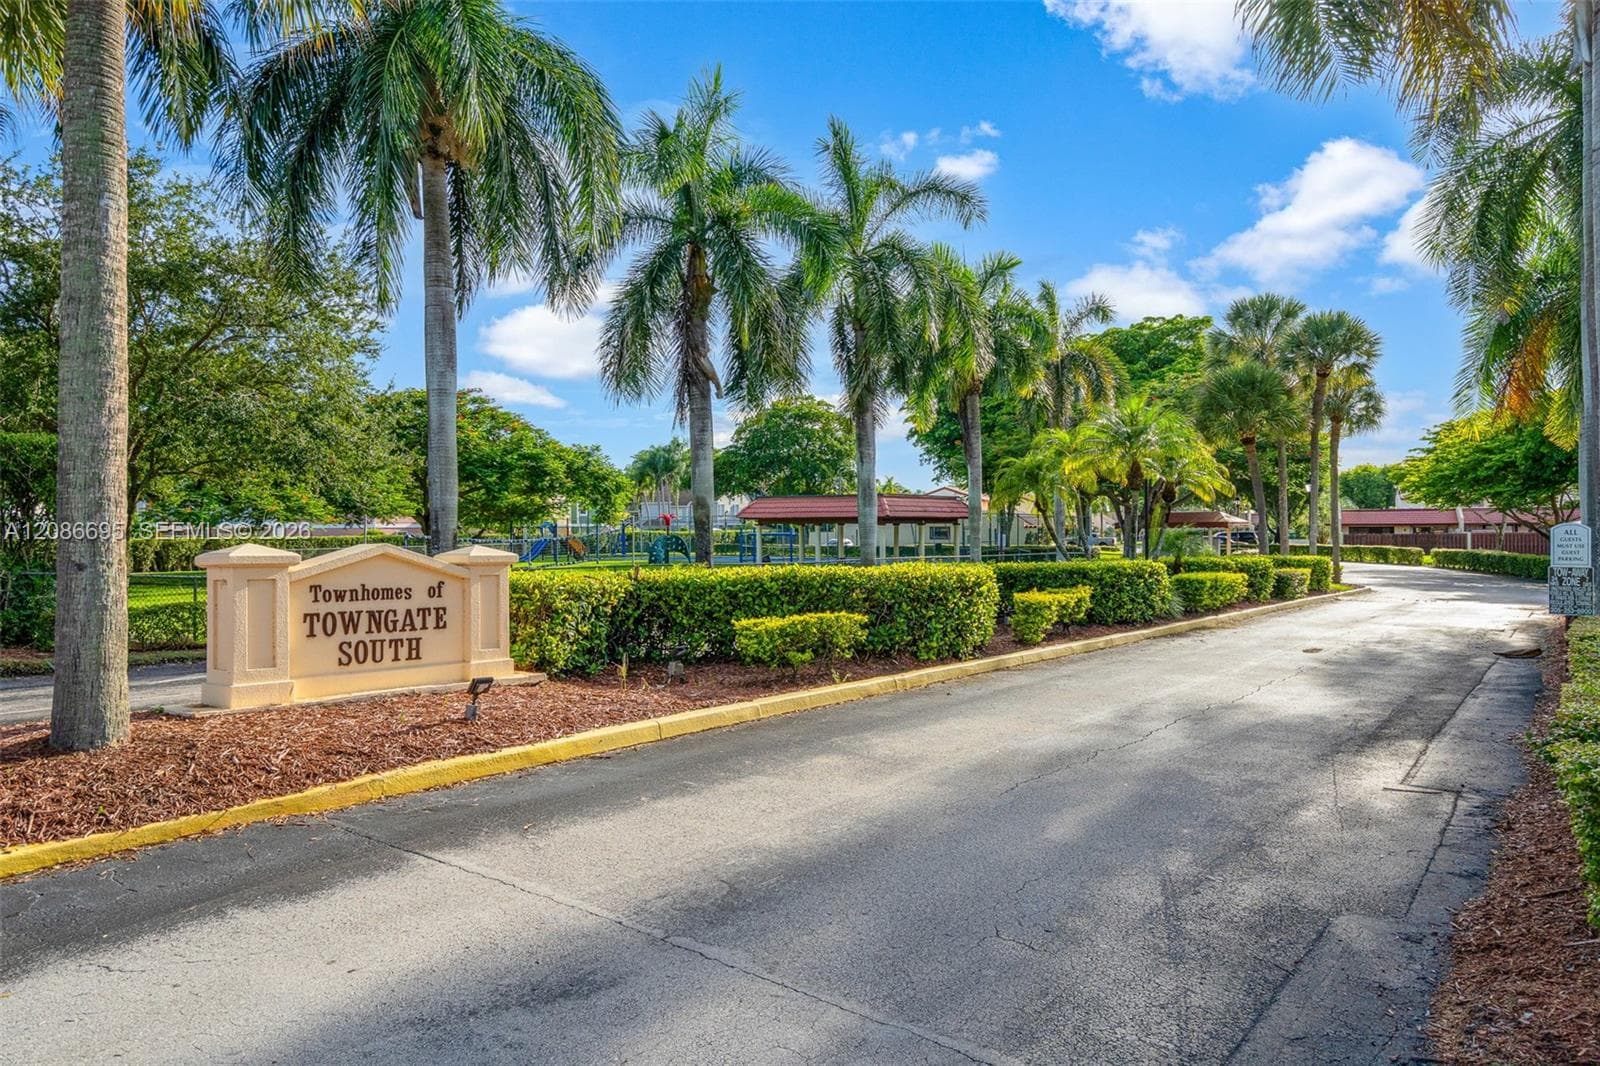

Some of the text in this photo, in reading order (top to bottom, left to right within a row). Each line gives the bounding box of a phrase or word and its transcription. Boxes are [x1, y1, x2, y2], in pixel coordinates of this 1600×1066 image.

[1553, 568, 1589, 577] TOW-AWAY
[1562, 577, 1581, 586] ZONE
[309, 581, 445, 603] Townhomes of
[303, 606, 447, 638] TOWNGATE
[338, 637, 422, 667] SOUTH
